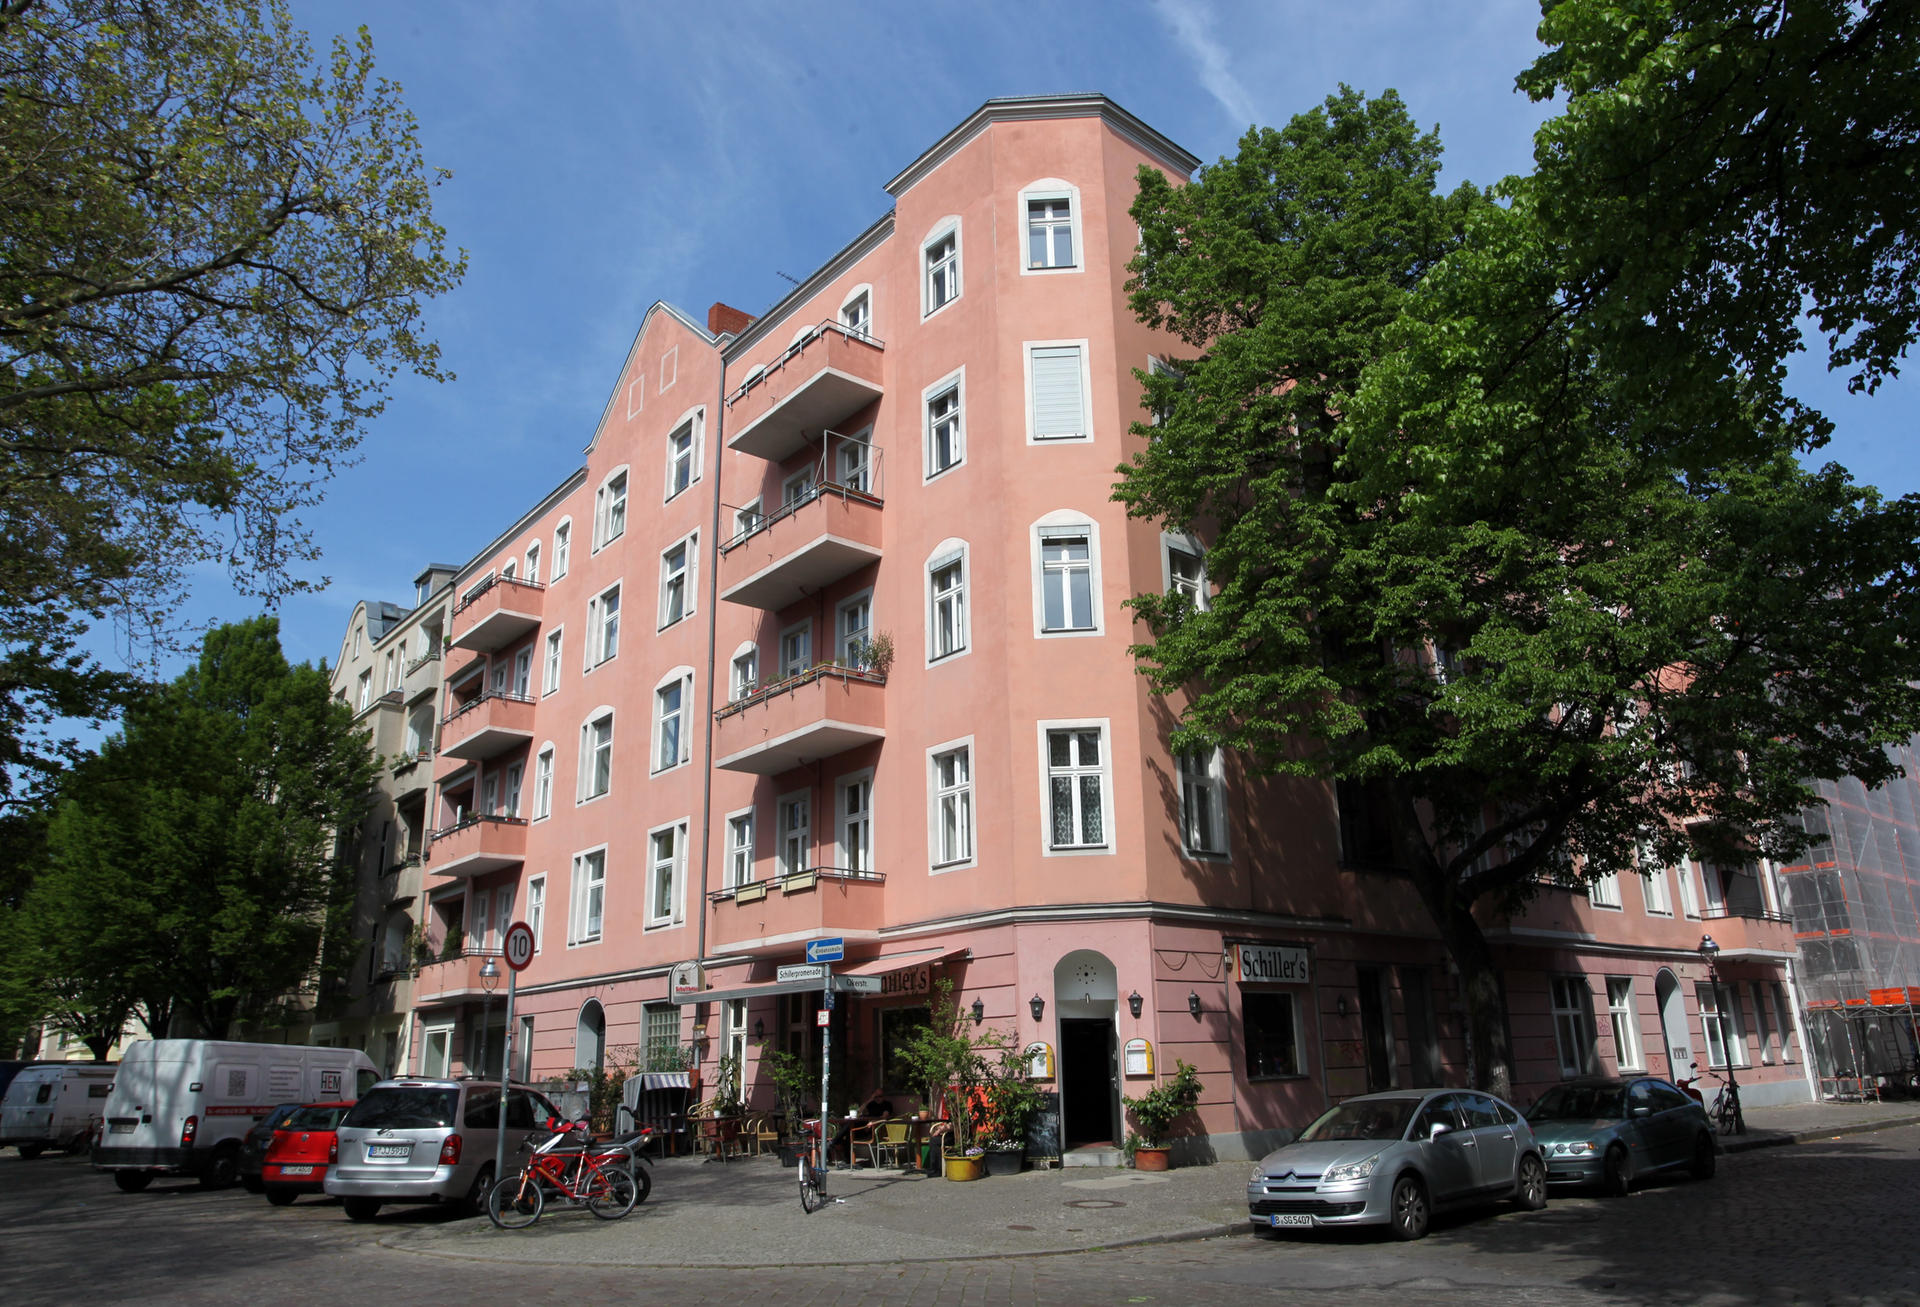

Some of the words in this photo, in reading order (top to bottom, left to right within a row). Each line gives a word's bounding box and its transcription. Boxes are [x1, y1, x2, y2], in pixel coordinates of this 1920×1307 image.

[513, 935, 527, 957] 10
[779, 967, 821, 979] Schillerpromenade
[1242, 950, 1306, 979] Schiller's
[321, 1075, 341, 1090] HEM
